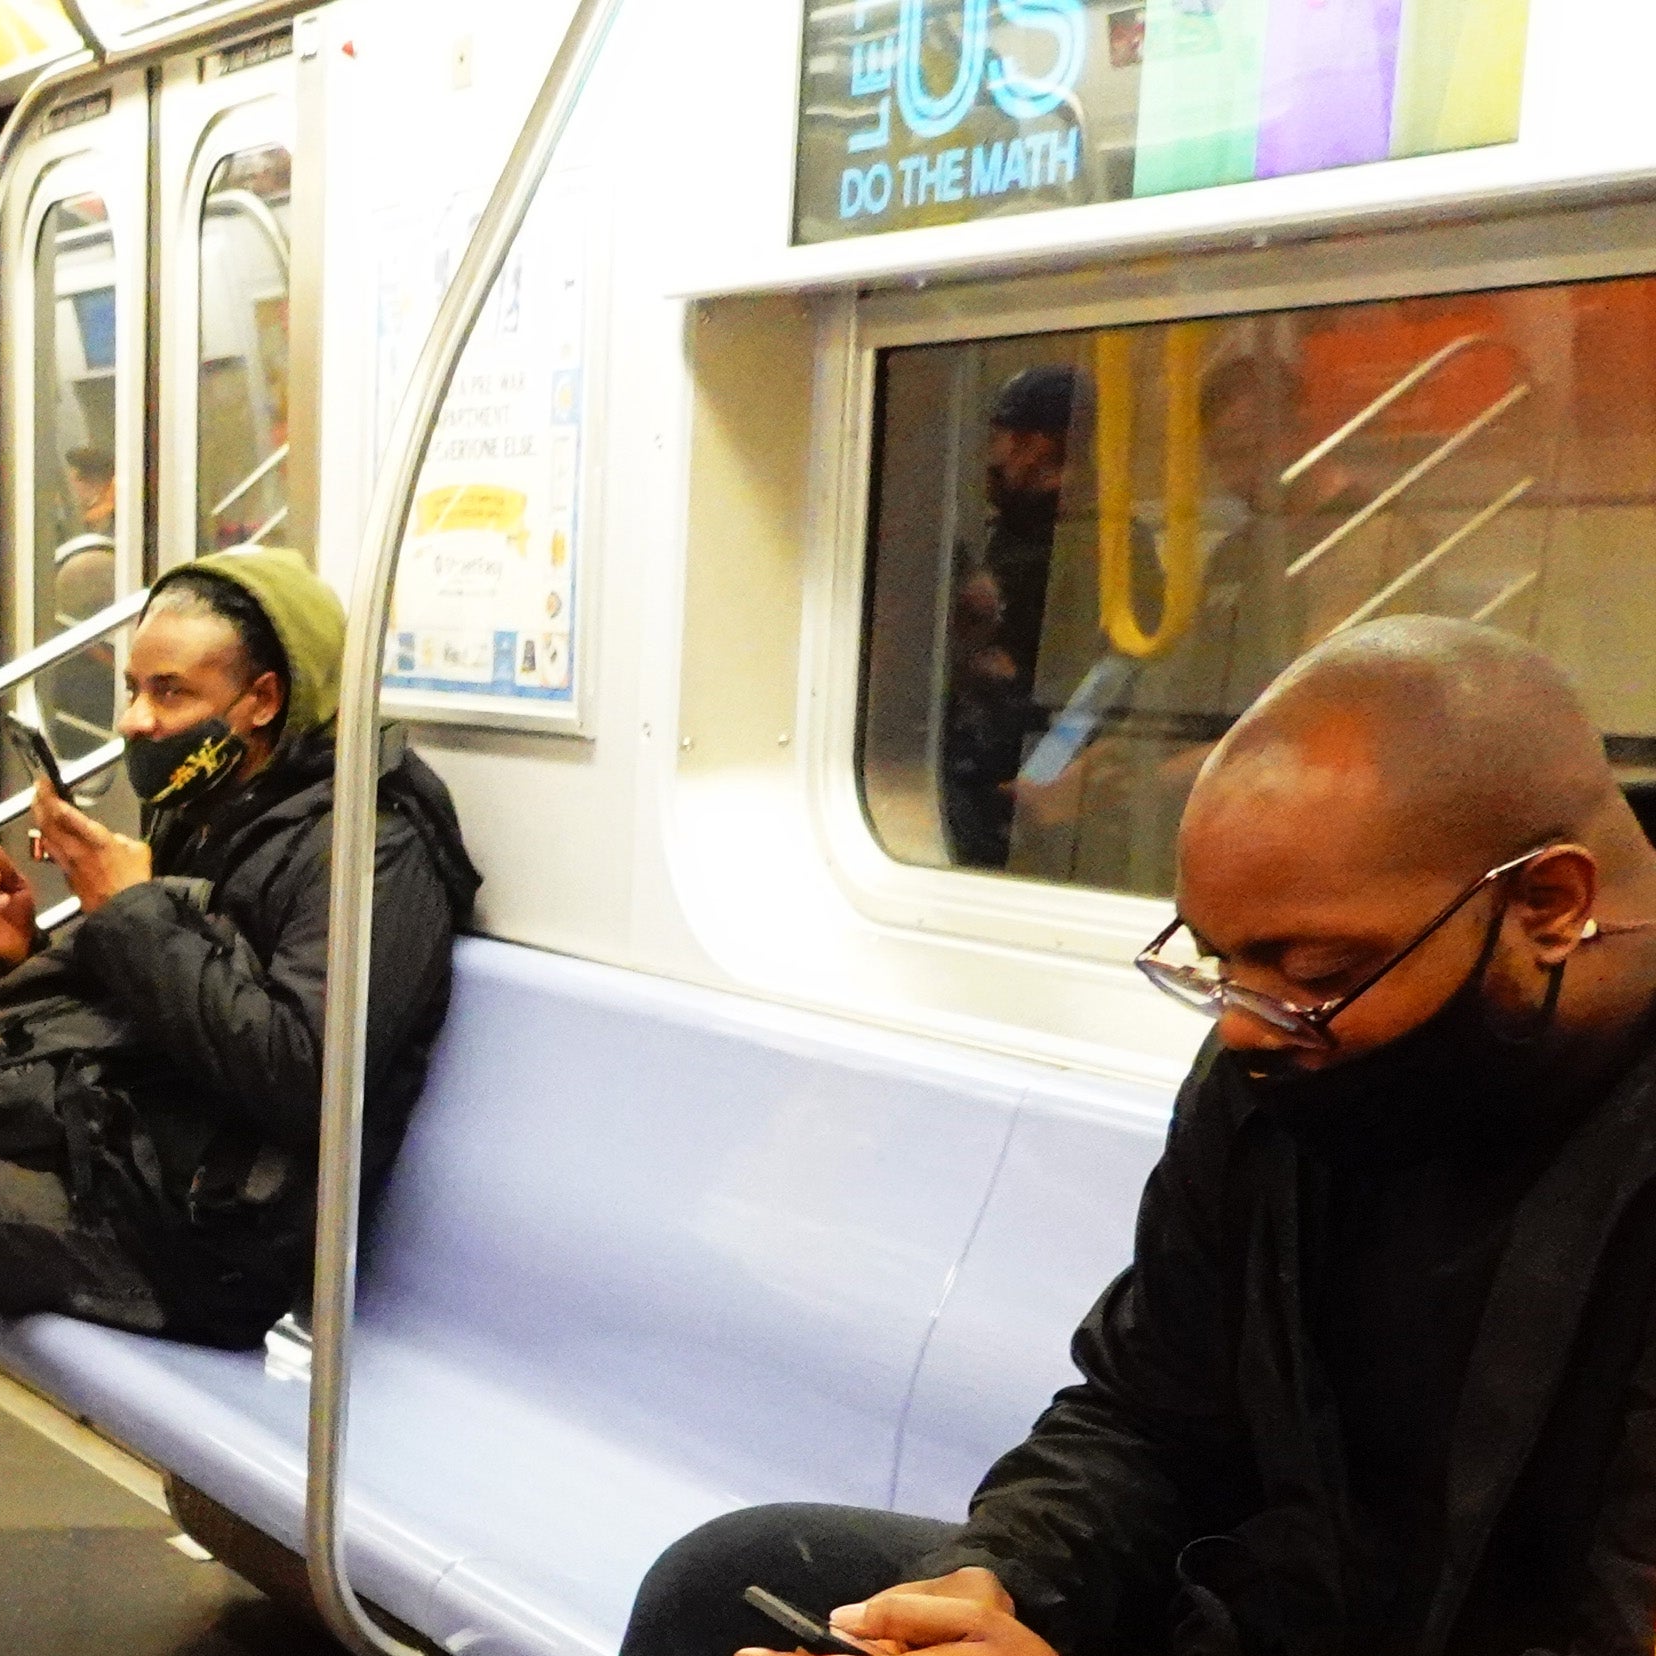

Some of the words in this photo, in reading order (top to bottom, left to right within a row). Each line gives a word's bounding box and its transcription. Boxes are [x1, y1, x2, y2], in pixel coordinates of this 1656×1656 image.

[839, 161, 893, 219] DO
[898, 148, 968, 208] THE
[970, 124, 1081, 197] MATH
